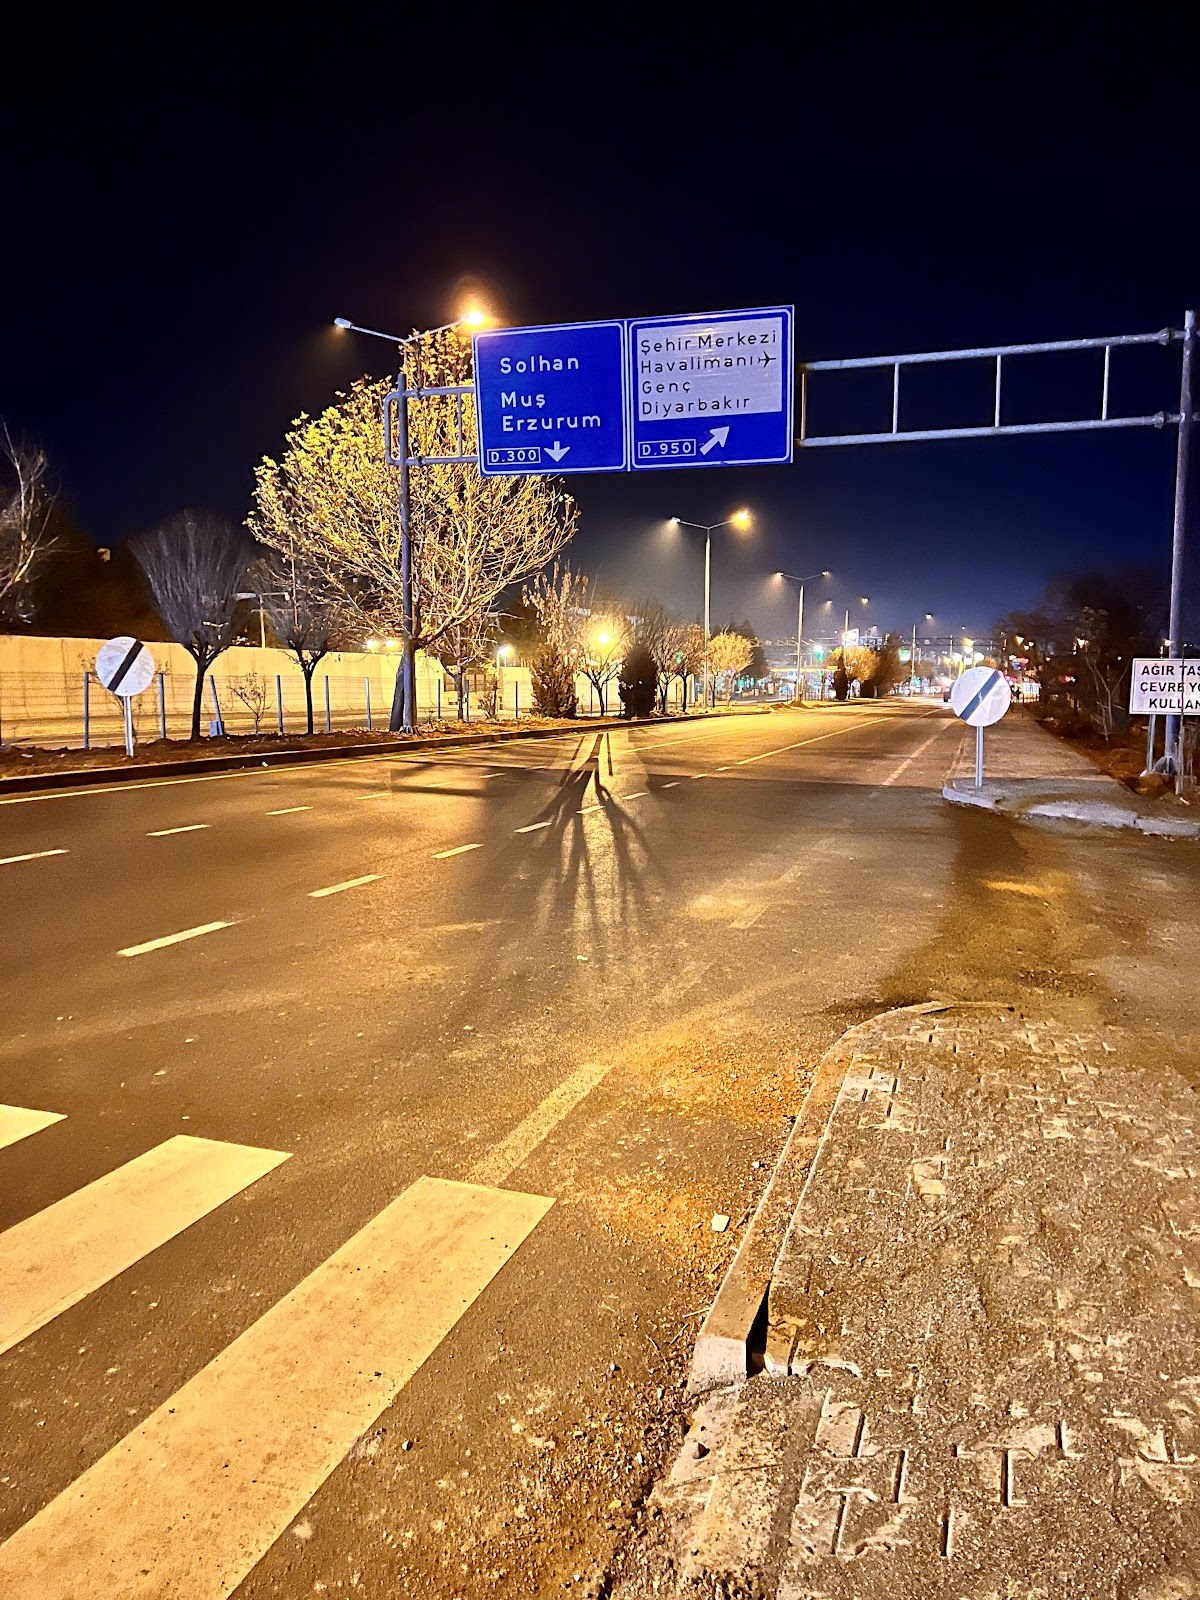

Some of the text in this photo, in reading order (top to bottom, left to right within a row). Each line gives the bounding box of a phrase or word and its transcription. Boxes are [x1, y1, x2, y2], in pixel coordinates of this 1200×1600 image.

[641, 330, 777, 355] Şehir Merkezi
[500, 356, 580, 374] Solhan
[641, 355, 754, 374] Havalimanı
[642, 380, 692, 394] Genç
[501, 391, 546, 409] Muş
[642, 395, 750, 417] Diyarbakır
[502, 414, 601, 432] Erzurum
[490, 449, 537, 463] D.300
[642, 441, 692, 456] D.950
[1141, 663, 1174, 675] AĞIR
[1140, 682, 1184, 694] ÇEVRE
